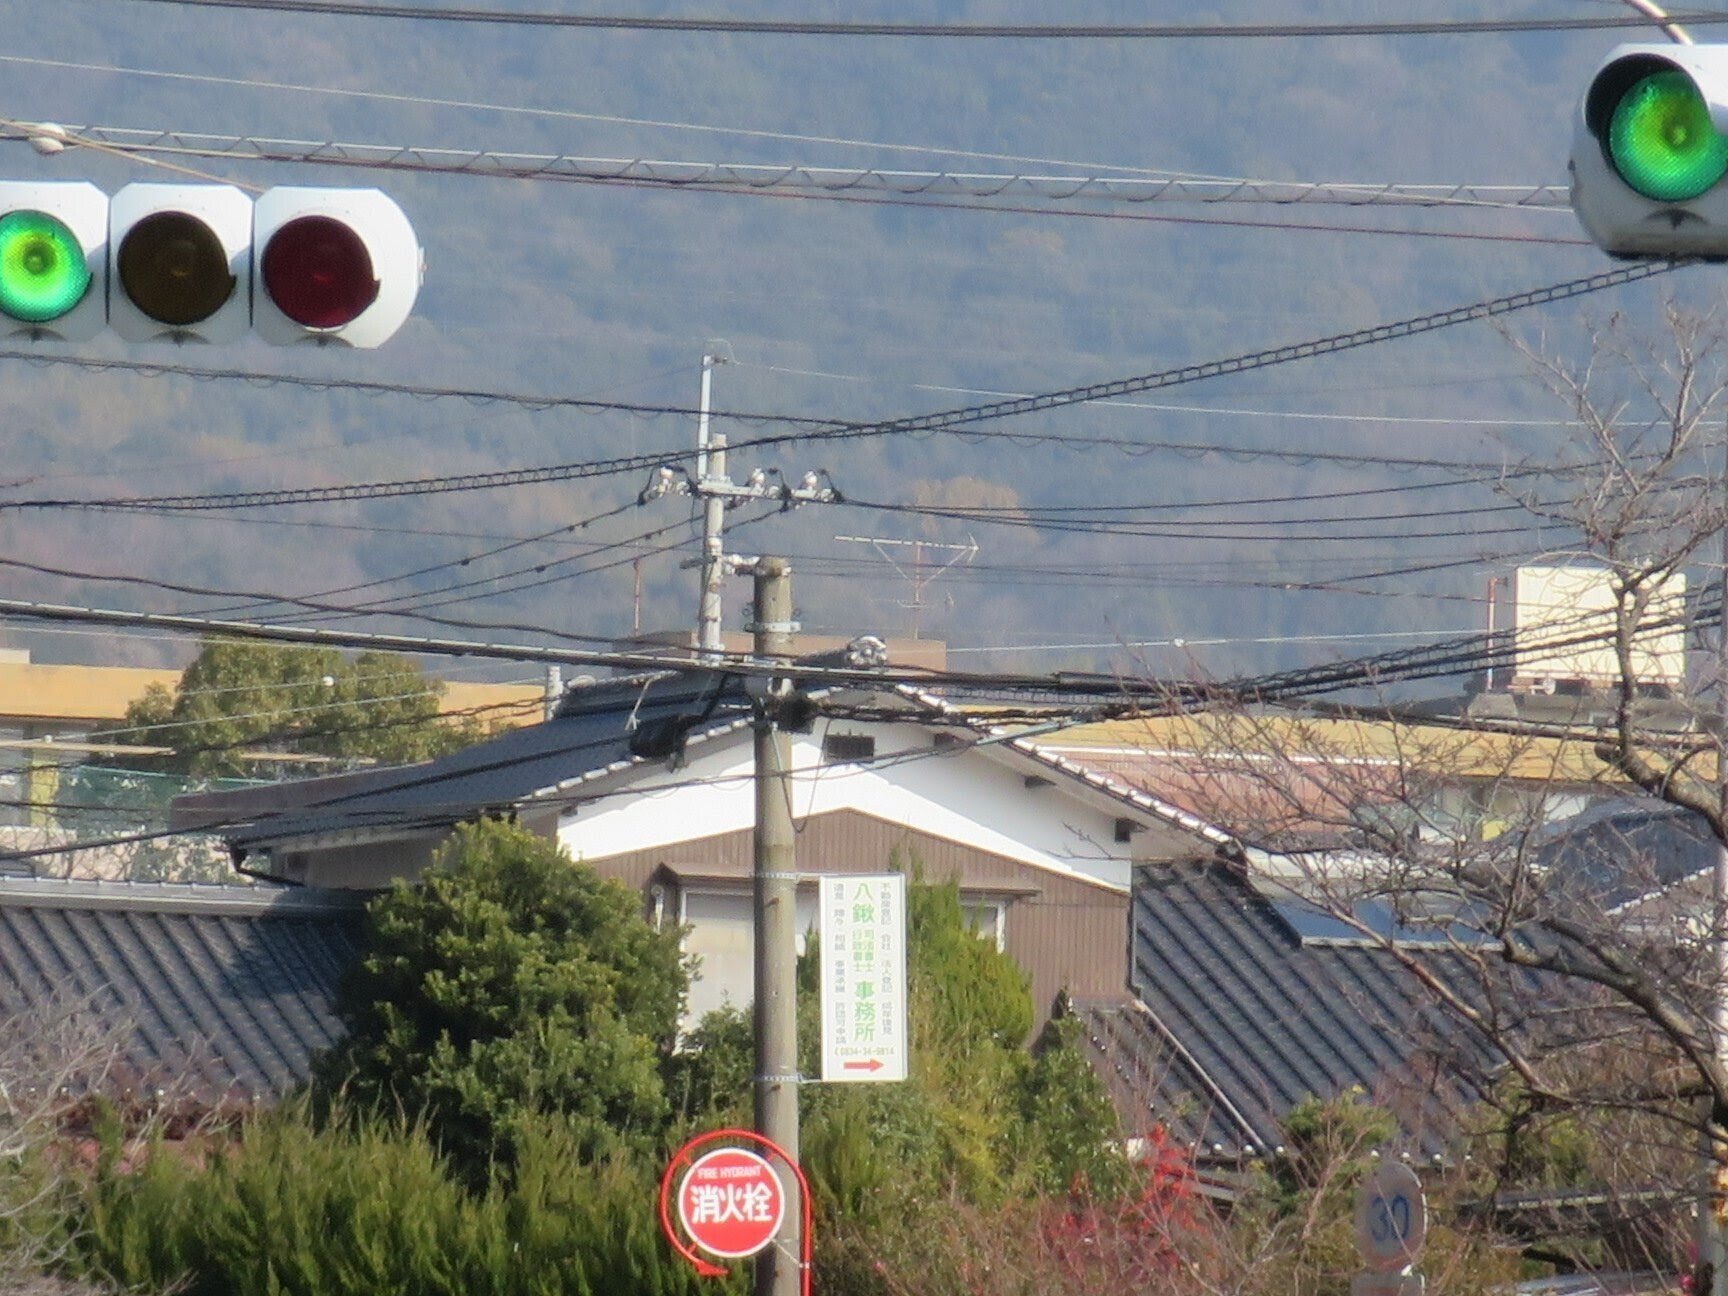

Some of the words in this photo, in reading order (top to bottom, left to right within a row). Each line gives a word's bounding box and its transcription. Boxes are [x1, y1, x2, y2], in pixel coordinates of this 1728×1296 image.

[853, 980, 876, 1041] 事務所
[697, 1167, 718, 1179] FIRE
[720, 1166, 761, 1178] HYDRANT
[690, 1181, 773, 1223] 消火栓
[1372, 1193, 1411, 1242] 30
